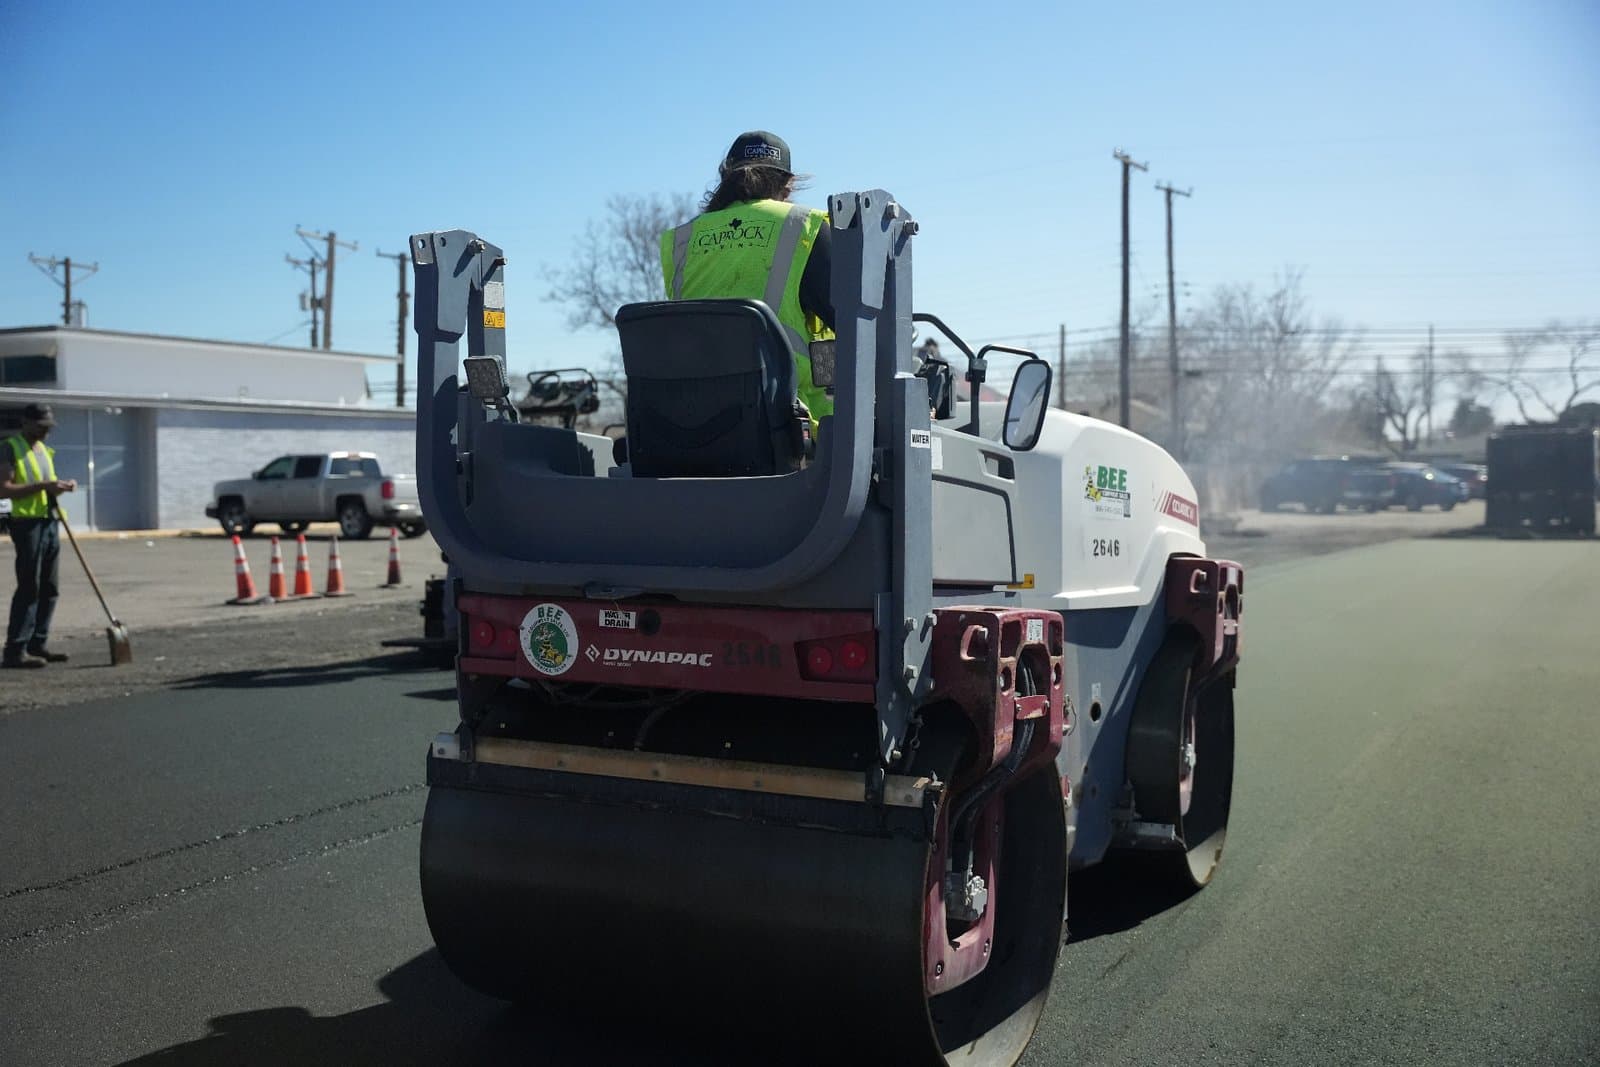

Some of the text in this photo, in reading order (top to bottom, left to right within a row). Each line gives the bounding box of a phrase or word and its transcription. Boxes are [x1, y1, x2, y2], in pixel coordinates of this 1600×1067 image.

[698, 226, 764, 247] CAPROCK
[912, 433, 930, 444] WATER
[1097, 465, 1128, 491] BEE
[1093, 539, 1120, 557] 2646
[537, 606, 564, 621] BEE
[604, 619, 630, 628] DRAIN
[603, 648, 713, 667] DYNAPAC
